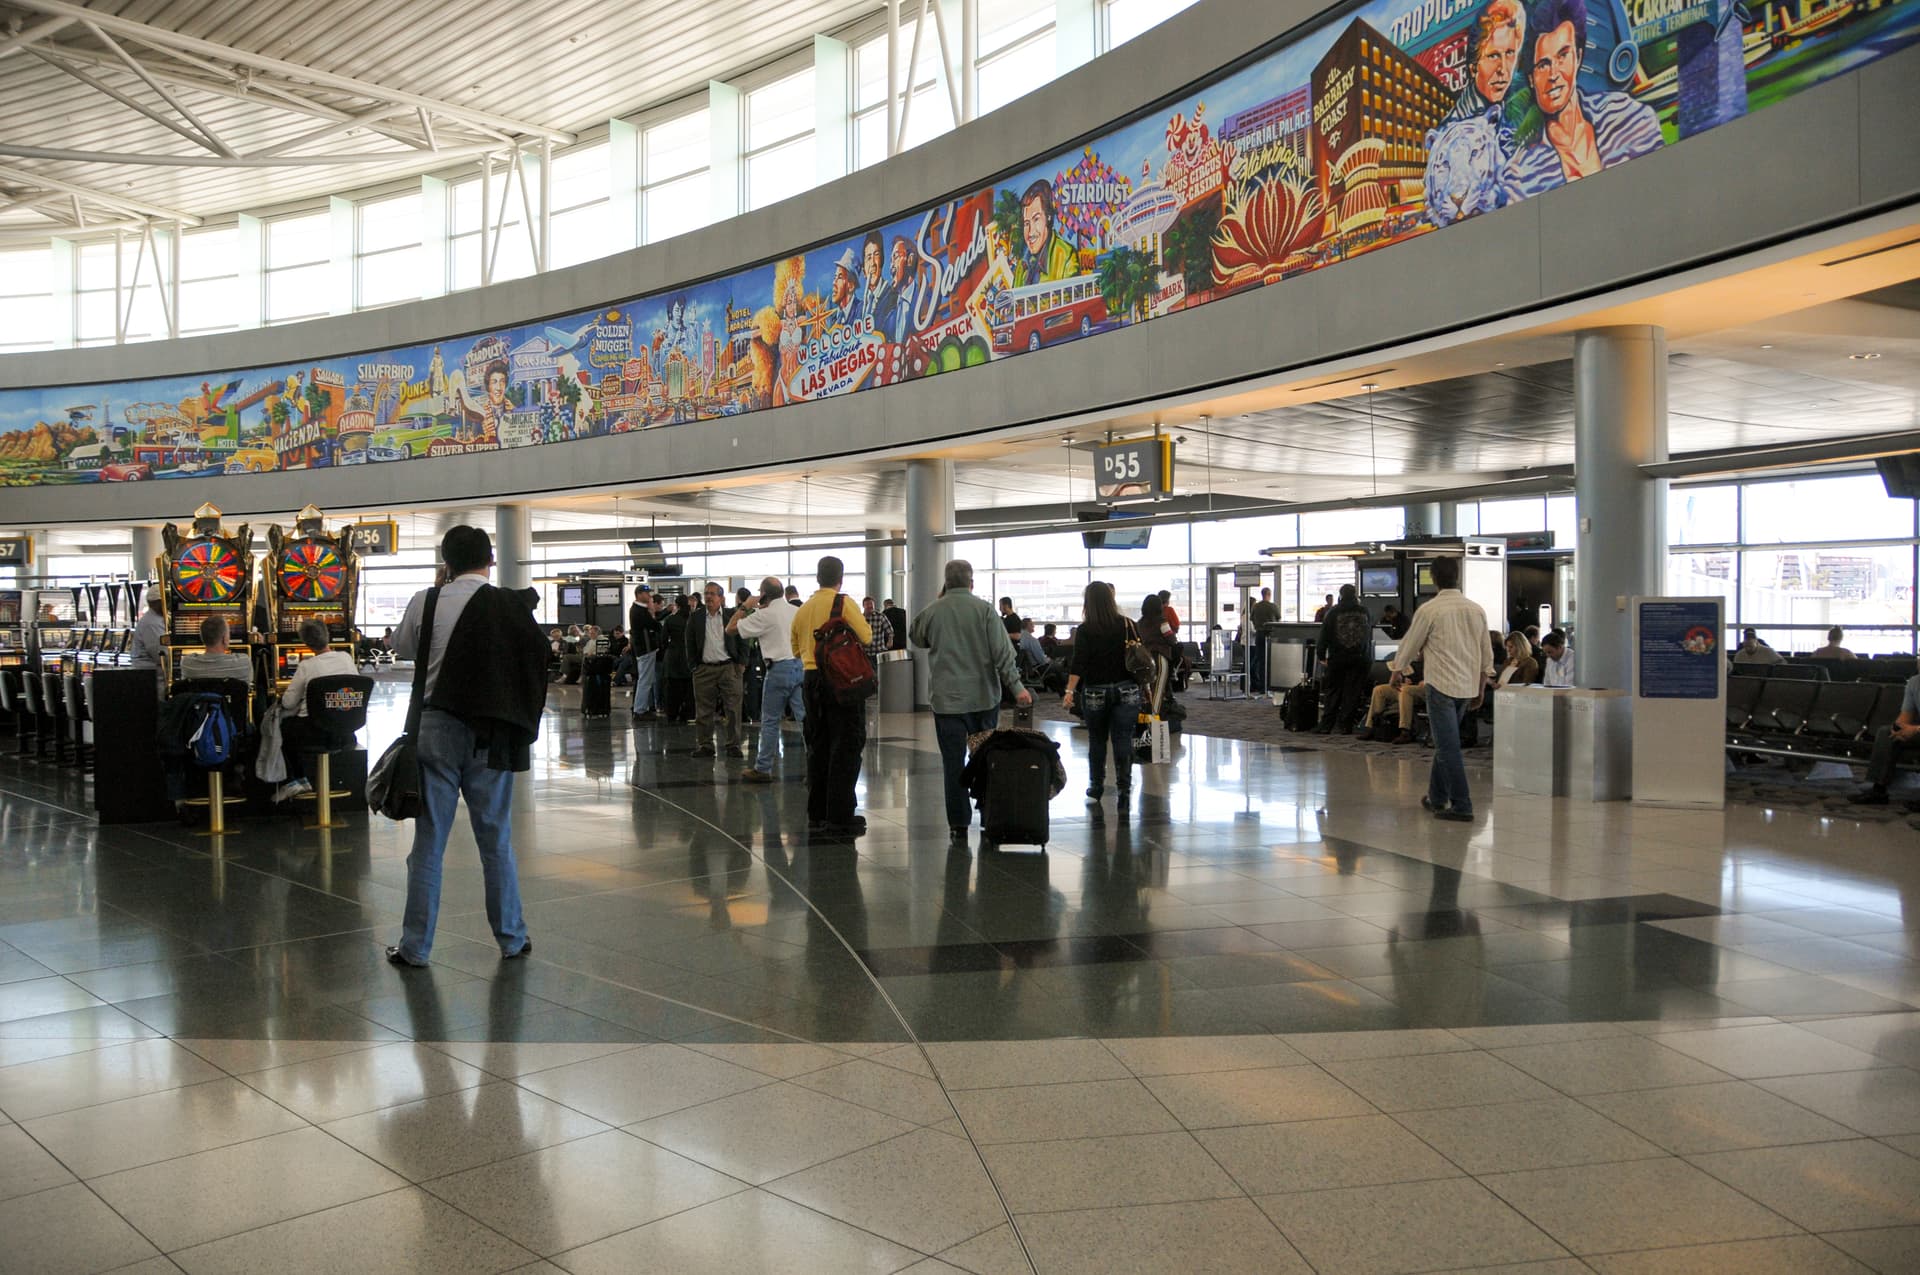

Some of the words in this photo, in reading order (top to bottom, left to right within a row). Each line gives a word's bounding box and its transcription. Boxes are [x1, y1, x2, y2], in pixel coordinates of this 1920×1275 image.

[1391, 0, 1474, 46] TROPICA
[1313, 65, 1356, 123] BARBARY
[1234, 122, 1278, 154] IMPERIAL
[1279, 108, 1312, 138] PALACE
[1321, 98, 1348, 136] COAST
[1190, 154, 1222, 184] CIRCUS
[1062, 183, 1128, 205] STARDUST
[1189, 170, 1222, 200] CASINO
[914, 201, 988, 331] Sands
[596, 325, 630, 338] GOLDEN
[799, 316, 873, 362] WELCOME
[945, 317, 974, 338] PACK
[592, 339, 630, 352] NUGGET
[808, 364, 816, 374] TO
[819, 340, 863, 369] Fabulous
[358, 363, 415, 380] SILVERBIRD
[801, 369, 827, 396] LAS
[829, 343, 876, 382] VEGAS
[400, 378, 430, 404] DUNES
[816, 377, 854, 400] NEVADA
[274, 420, 321, 453] HACIENDA
[340, 413, 375, 432] ALADDIN
[217, 439, 238, 449] HOTEL
[431, 444, 464, 457] SILVER
[1104, 451, 1141, 480] D55
[357, 529, 380, 545] D56
